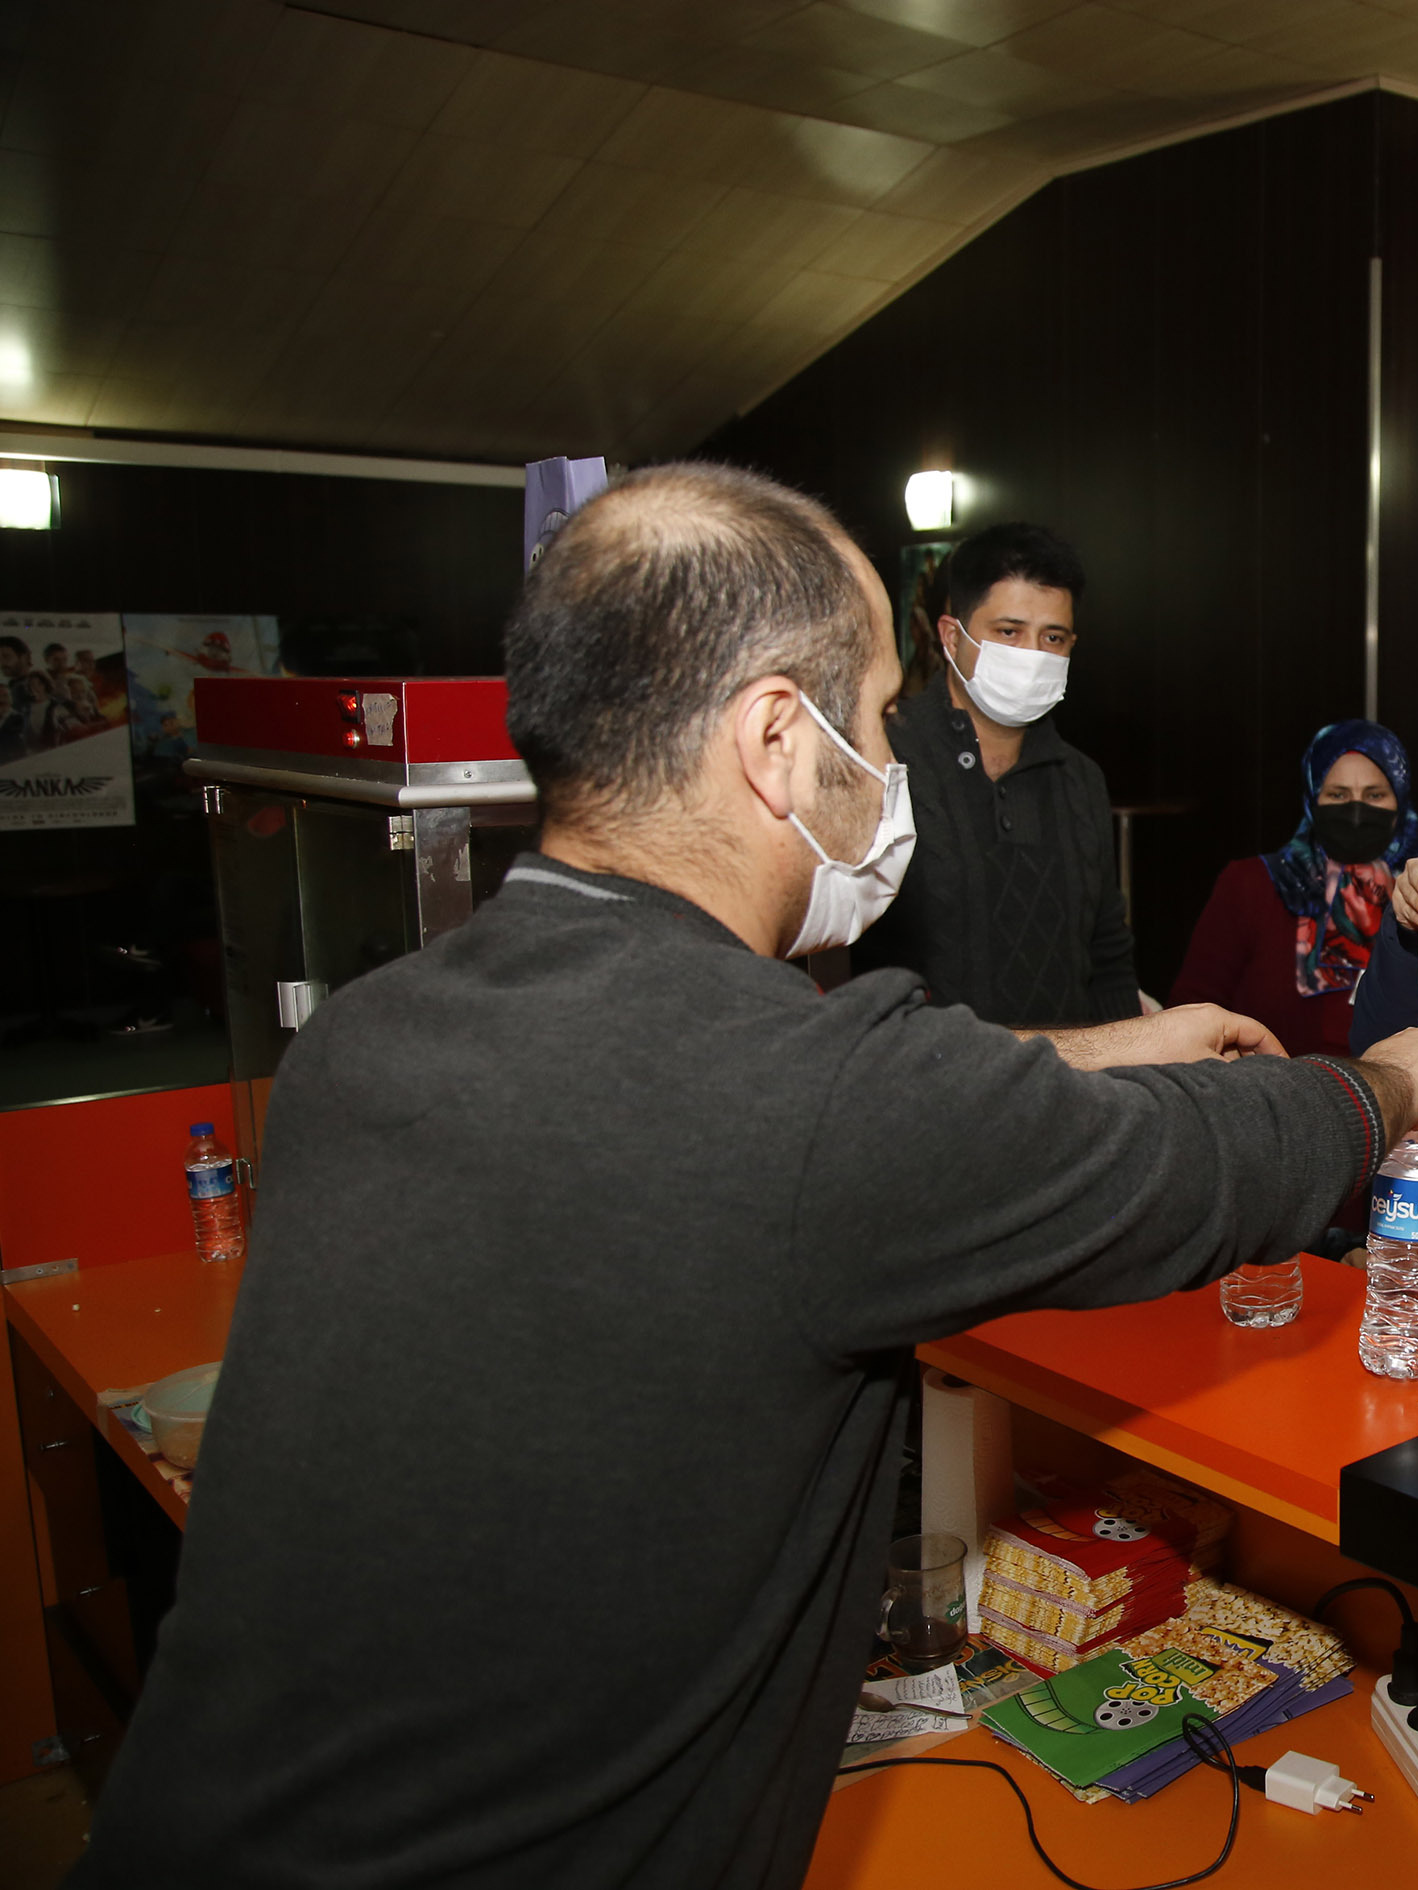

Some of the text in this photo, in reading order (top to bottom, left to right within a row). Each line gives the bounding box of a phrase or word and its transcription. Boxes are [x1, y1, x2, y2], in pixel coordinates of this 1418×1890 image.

[1130, 1659, 1181, 1688] CORN
[1162, 1651, 1206, 1677] midi
[1107, 1683, 1176, 1706] POP
